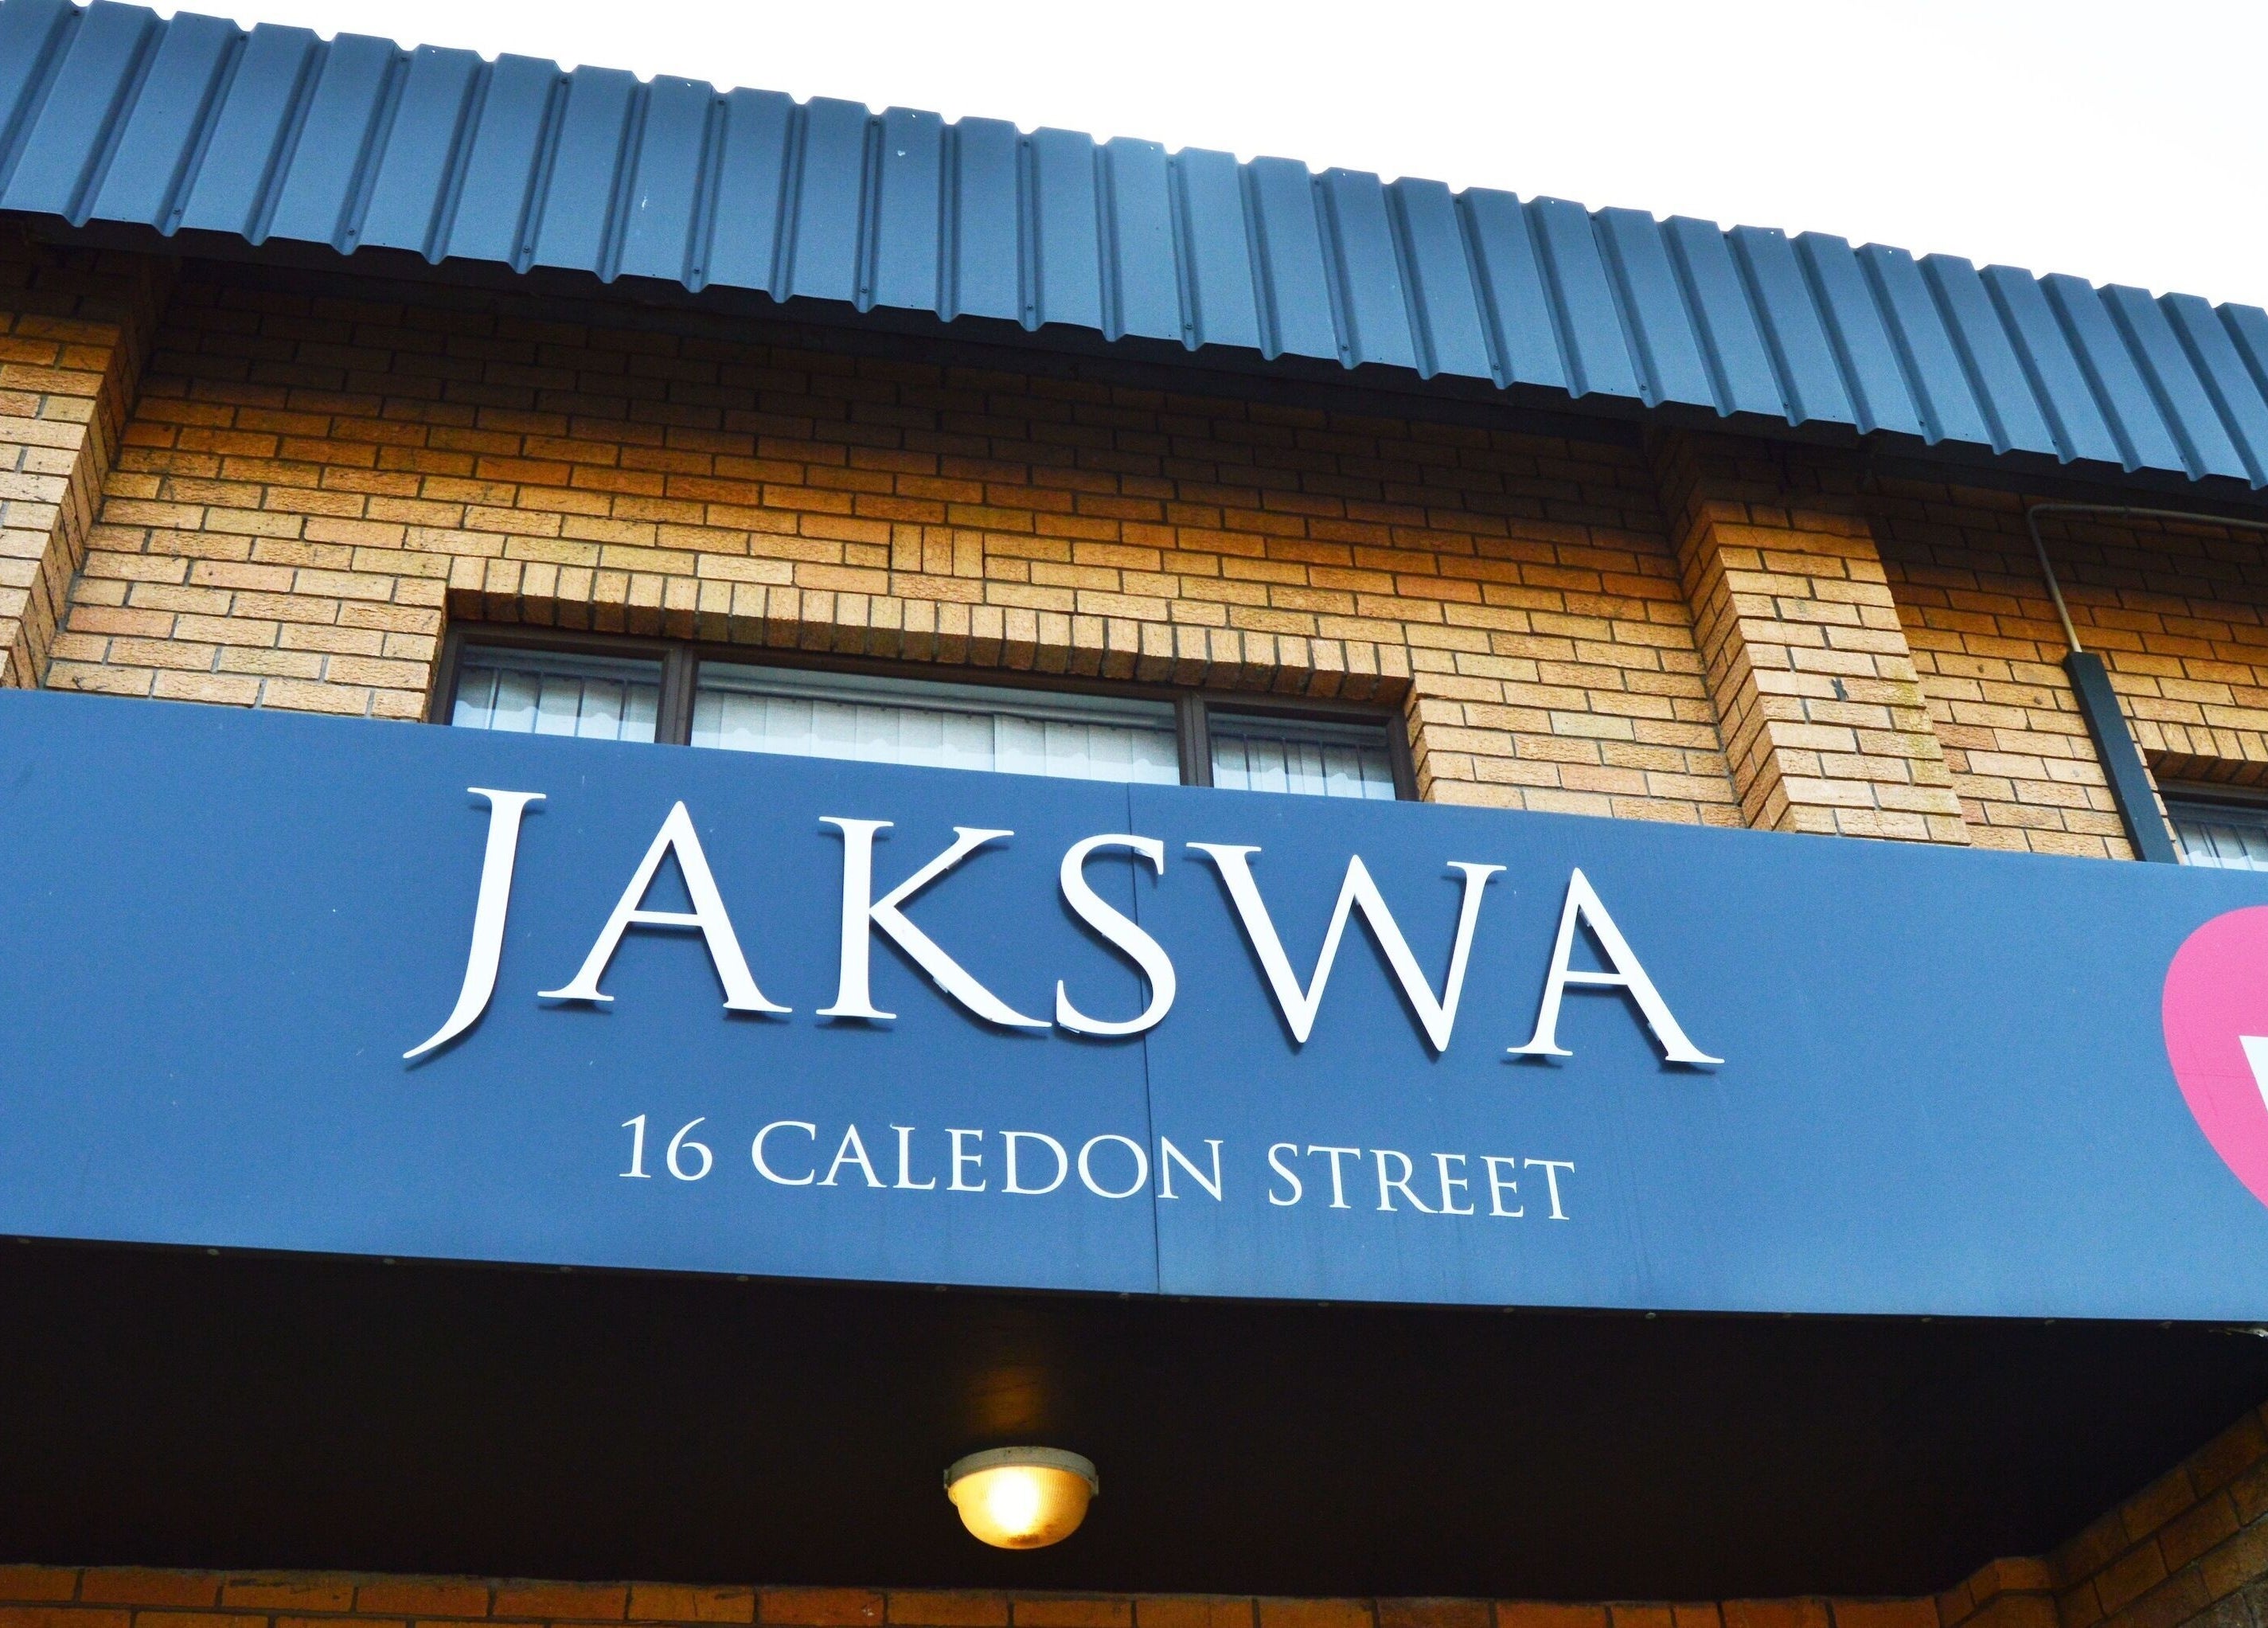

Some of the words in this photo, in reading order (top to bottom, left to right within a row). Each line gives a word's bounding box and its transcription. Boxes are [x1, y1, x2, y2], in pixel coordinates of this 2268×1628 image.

[402, 787, 1726, 1064] JAKSWA
[619, 1114, 714, 1181] 16
[751, 1120, 1224, 1202] CALEDON
[1267, 1142, 1575, 1221] STREET
